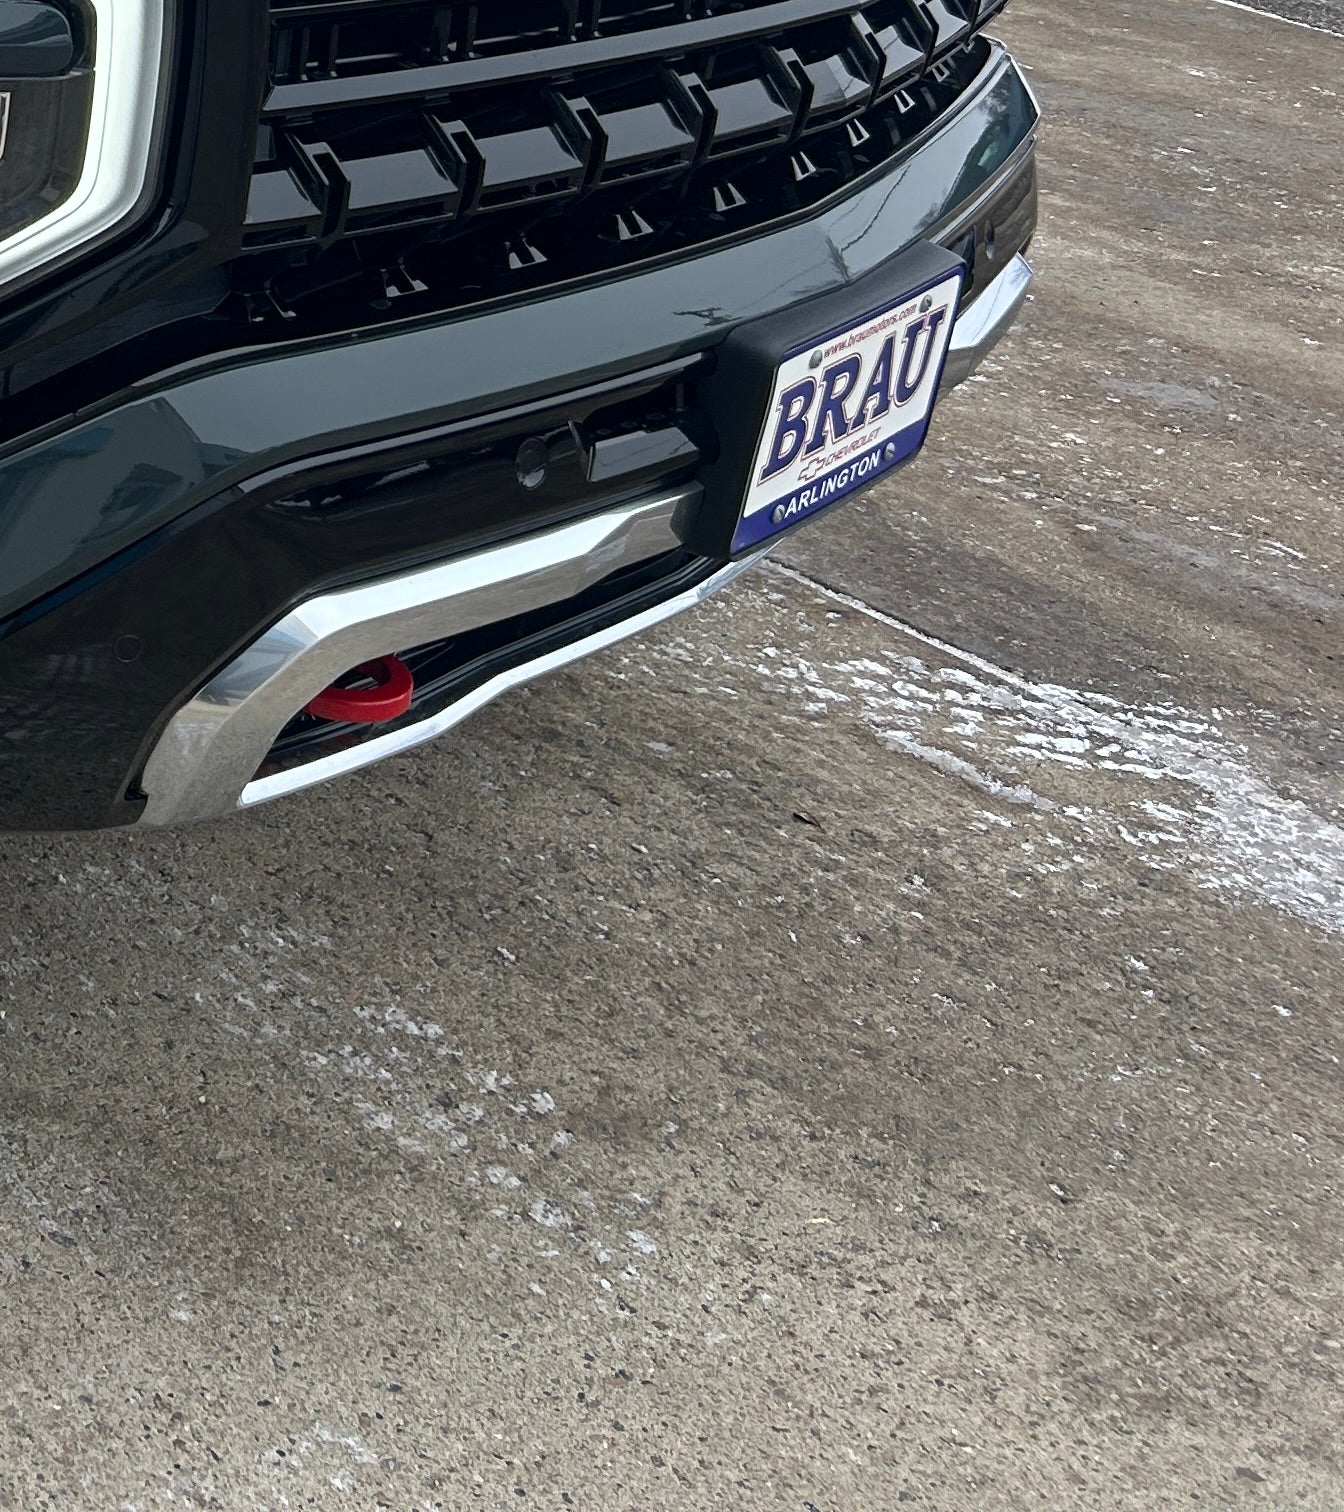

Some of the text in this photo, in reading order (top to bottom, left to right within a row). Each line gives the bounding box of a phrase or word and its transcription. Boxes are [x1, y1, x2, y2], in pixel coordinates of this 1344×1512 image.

[757, 304, 948, 486] BRAU
[823, 426, 882, 467] CHEVROLET
[783, 449, 882, 519] ARLINGTON
